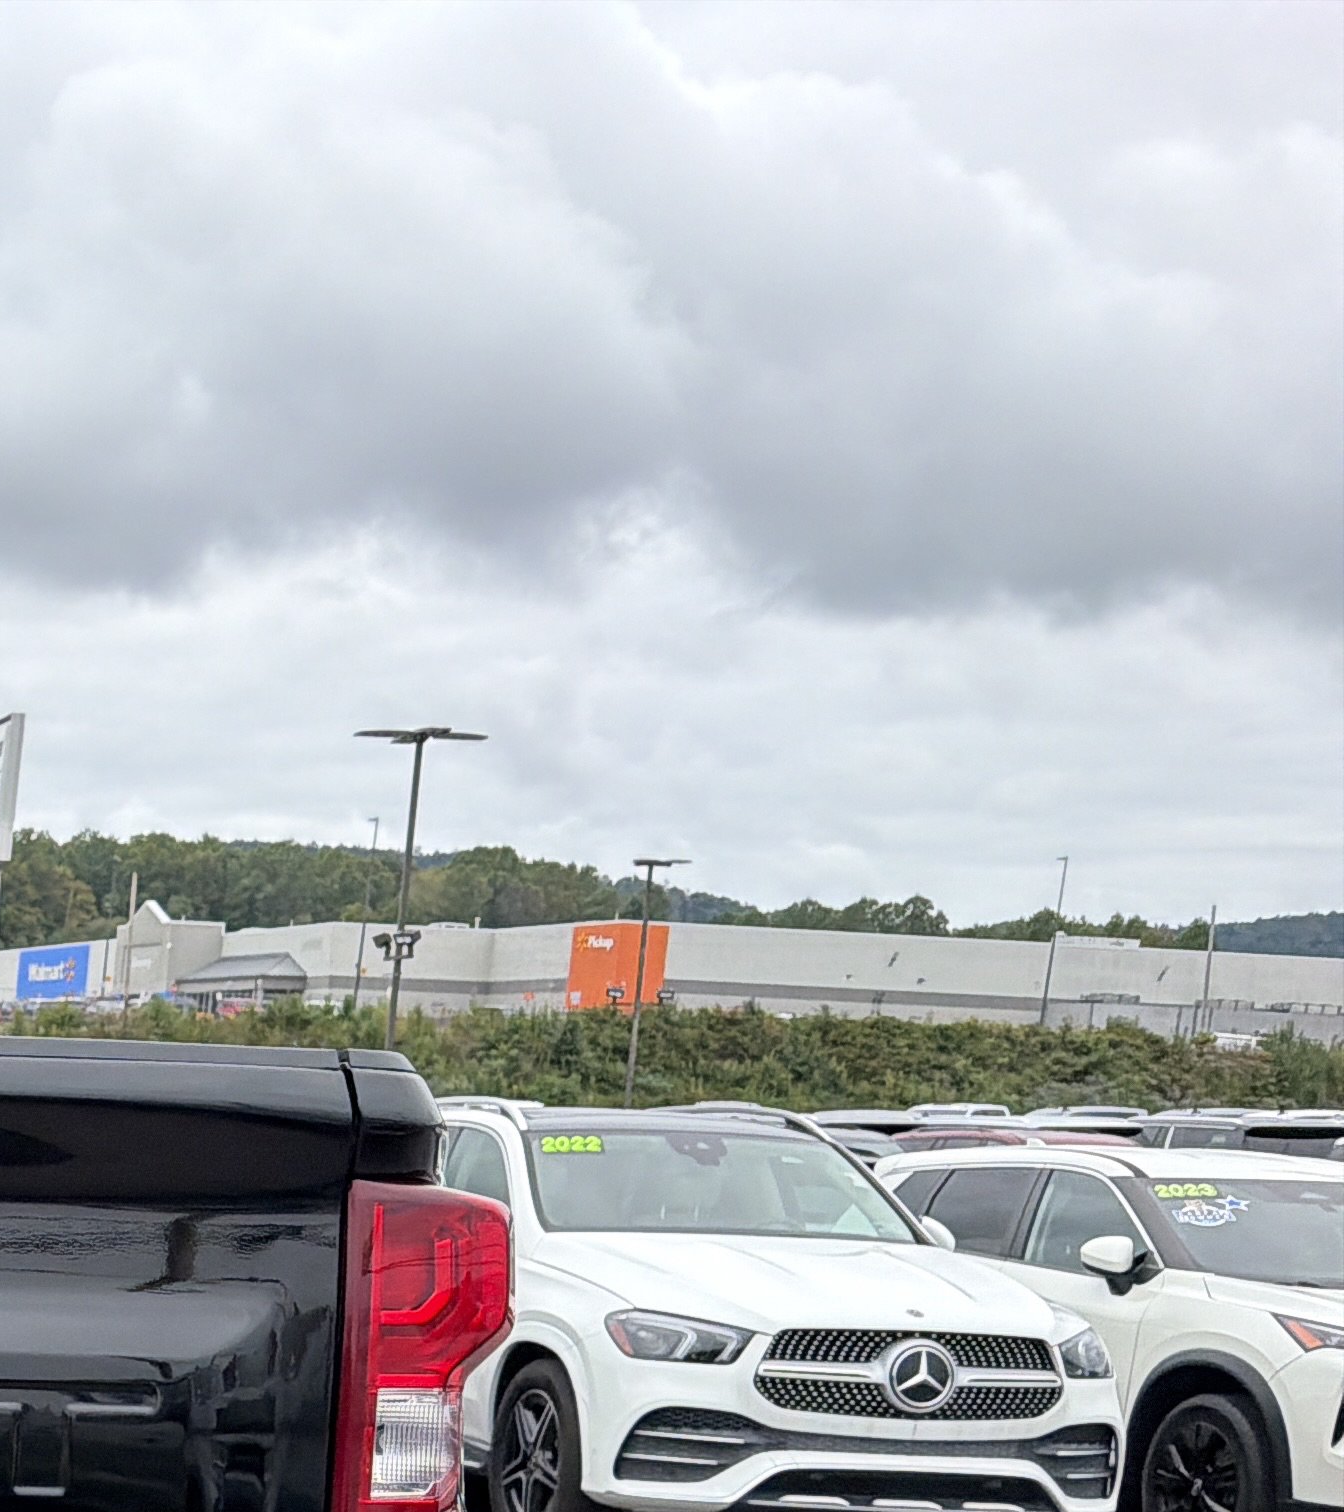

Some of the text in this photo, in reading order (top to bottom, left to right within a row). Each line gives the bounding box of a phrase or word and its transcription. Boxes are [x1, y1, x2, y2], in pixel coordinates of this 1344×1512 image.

[587, 935, 614, 952] Pickup
[28, 959, 66, 982] Walmart
[541, 1135, 602, 1153] 2022
[1153, 1183, 1218, 1198] 2023
